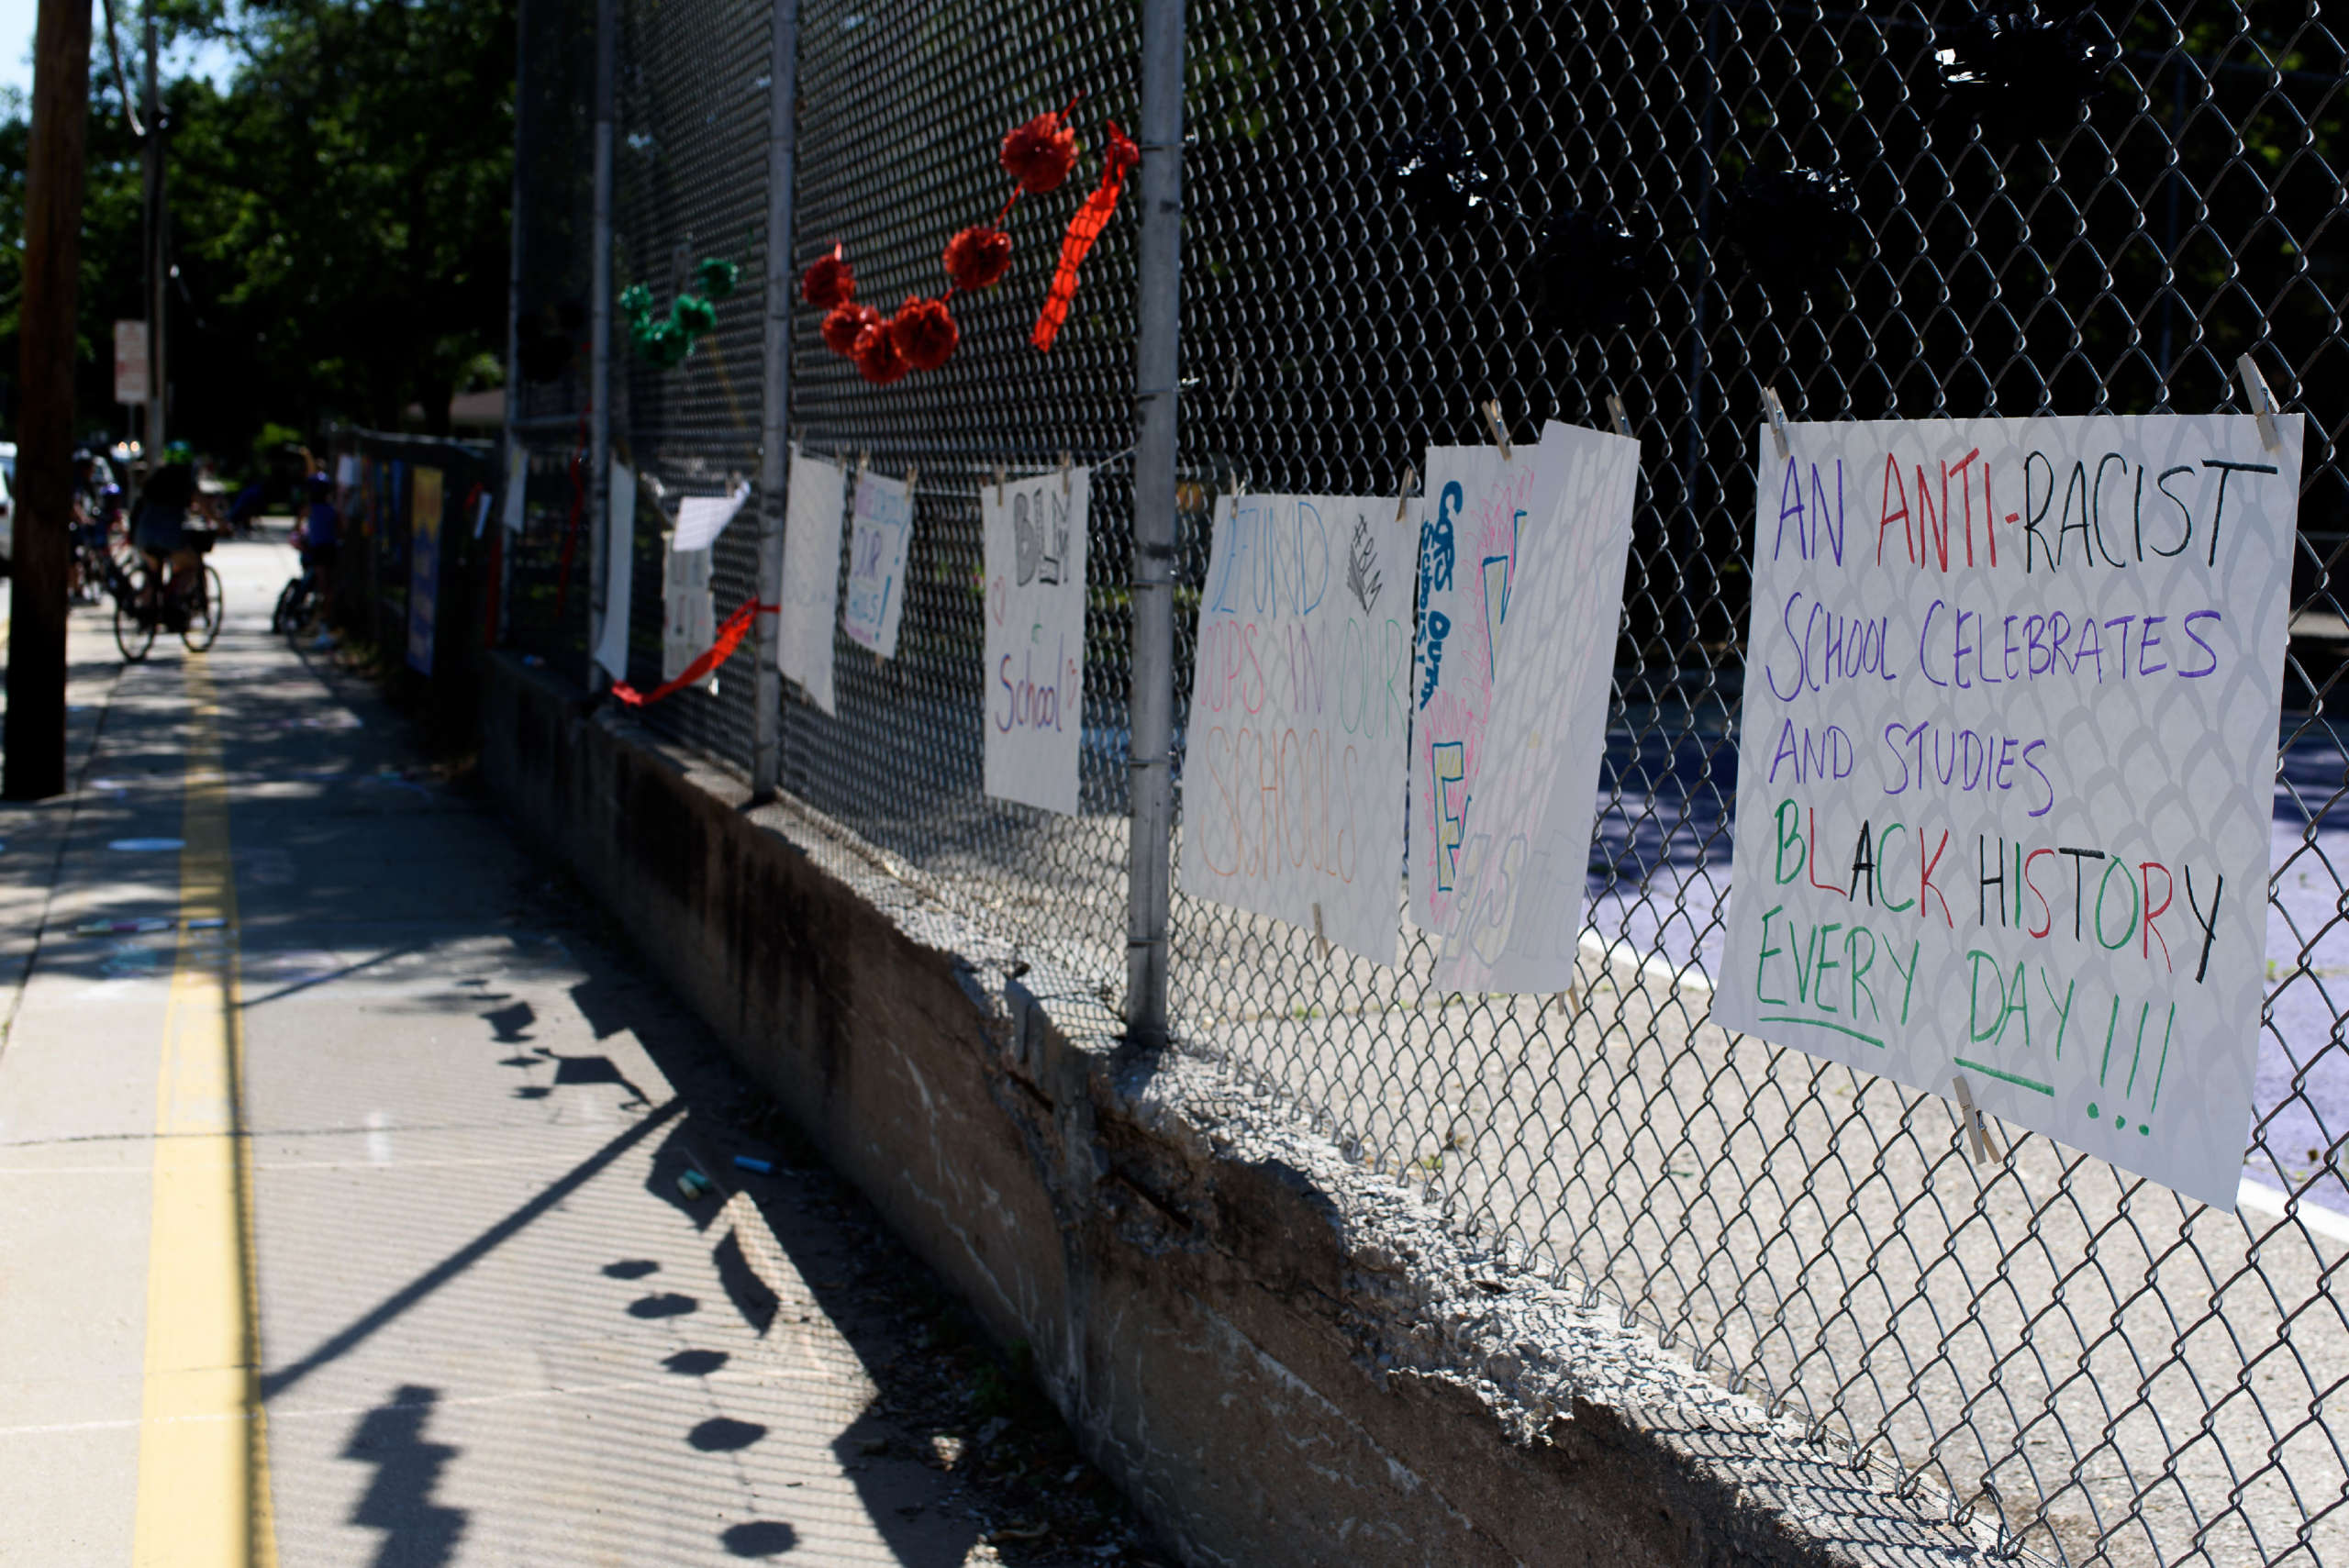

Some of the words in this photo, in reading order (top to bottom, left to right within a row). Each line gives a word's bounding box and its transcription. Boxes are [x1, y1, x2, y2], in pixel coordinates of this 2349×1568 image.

[1773, 454, 1844, 569] AN
[1876, 447, 2279, 574] ANTI-RACIST
[995, 631, 1063, 732] School
[1287, 617, 1328, 715] IN
[1340, 616, 1409, 740] OUR
[1765, 591, 1897, 703] SCHOOL
[1919, 598, 2222, 690] CELEBRATES
[1201, 725, 1360, 885] SCHOOLS
[1768, 717, 1854, 785] AND
[1883, 720, 2054, 818] STUDIES
[1774, 797, 1954, 929] BLACK
[1979, 832, 2223, 984] HISTORY
[1755, 904, 1920, 1027] EVERY
